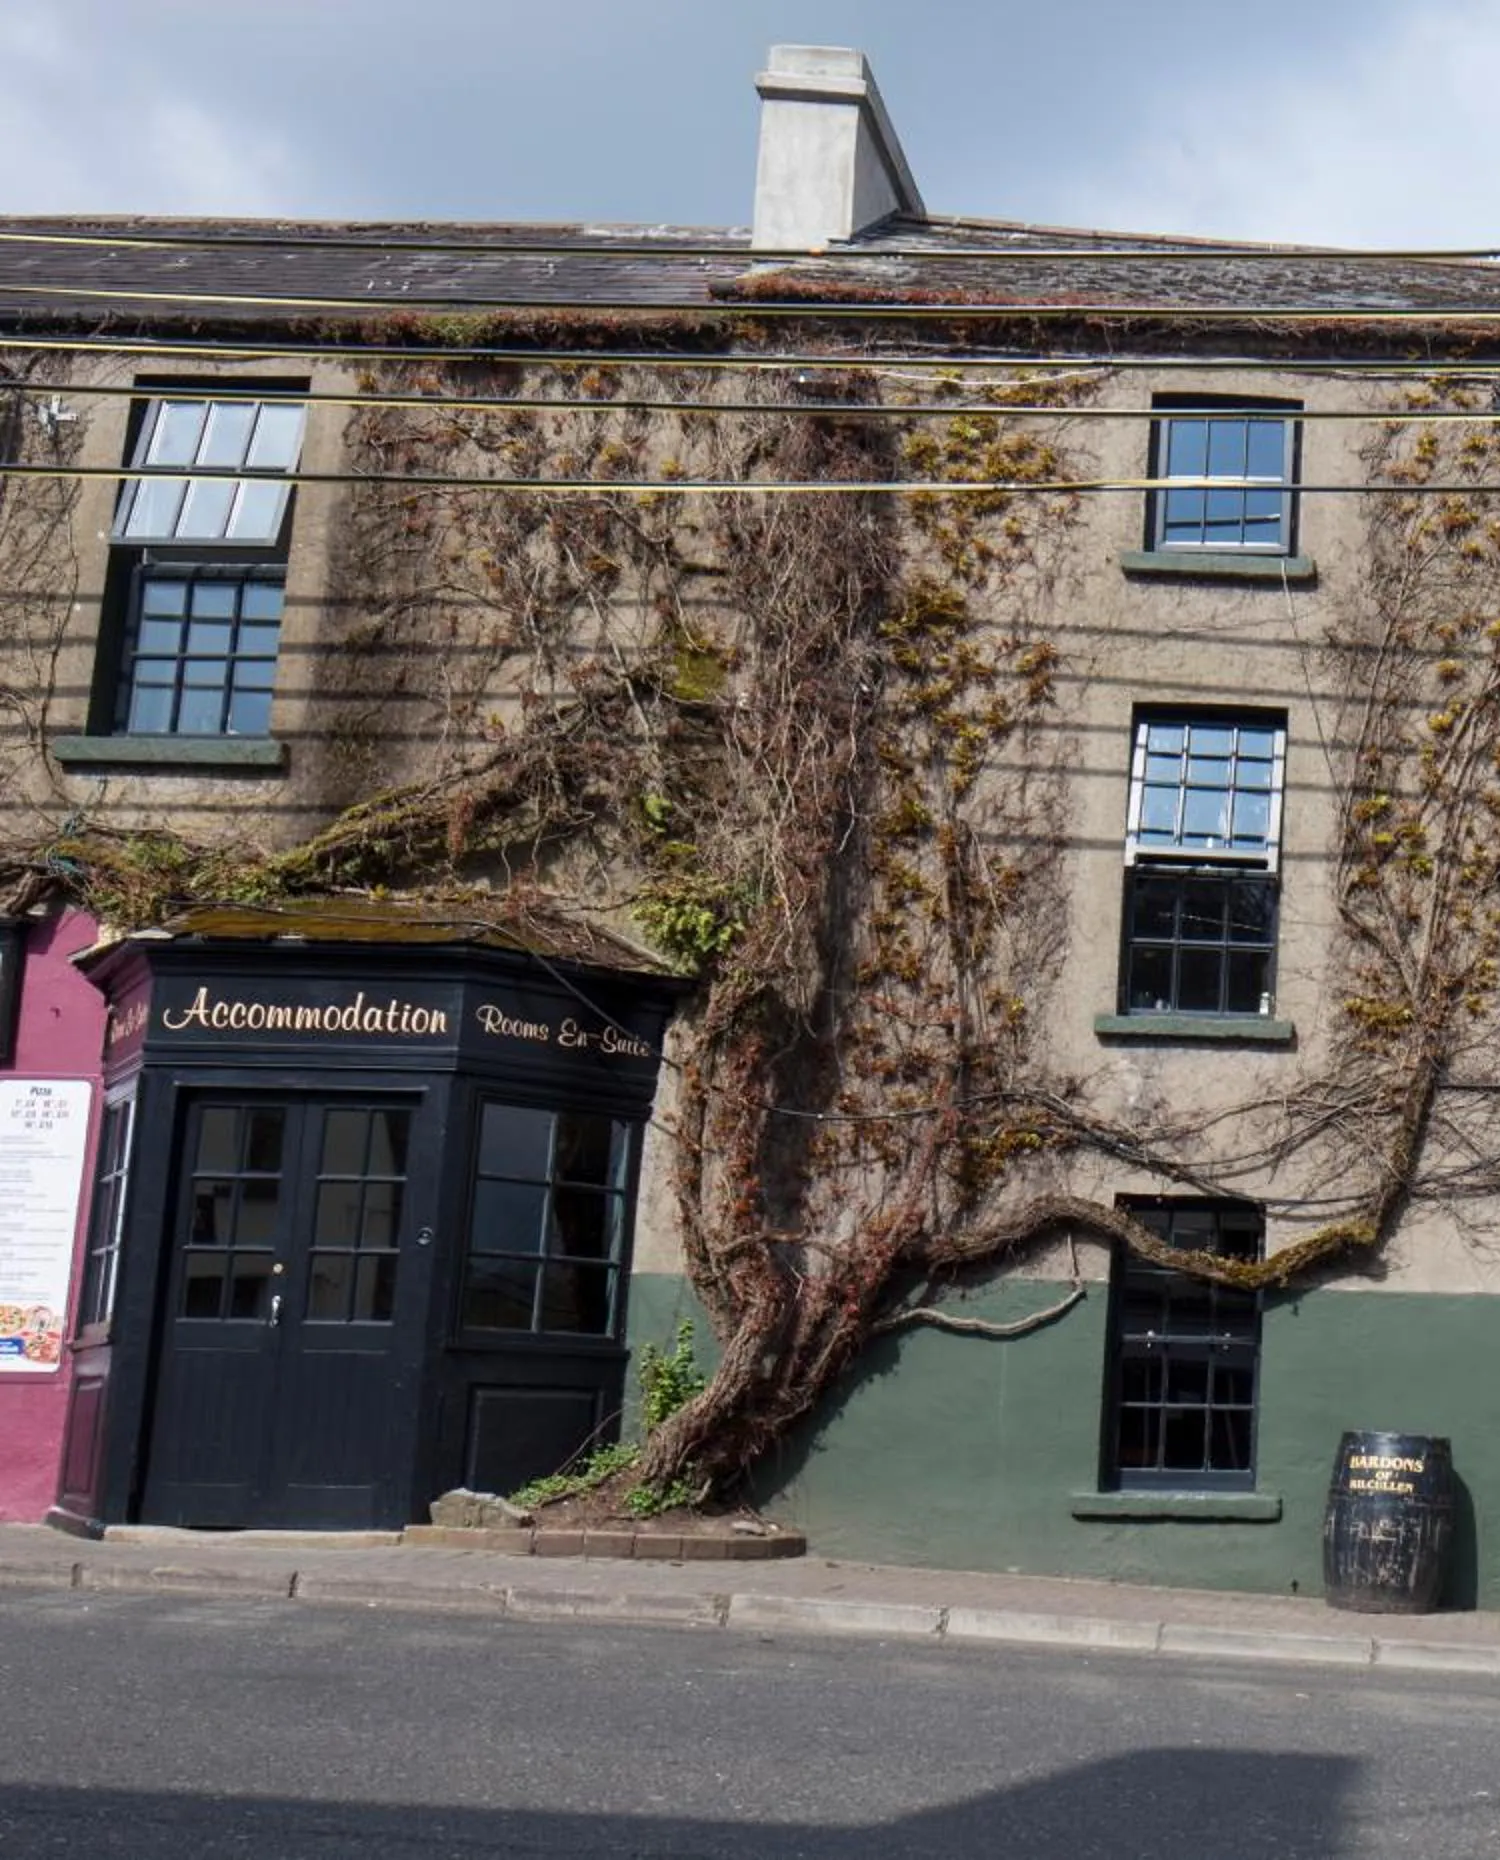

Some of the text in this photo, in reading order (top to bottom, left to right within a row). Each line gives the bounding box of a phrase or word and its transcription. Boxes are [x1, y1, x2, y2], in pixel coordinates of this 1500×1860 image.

[163, 987, 447, 1034] Accommodation
[476, 1005, 549, 1041] Rooms
[1375, 1470, 1393, 1481] OF
